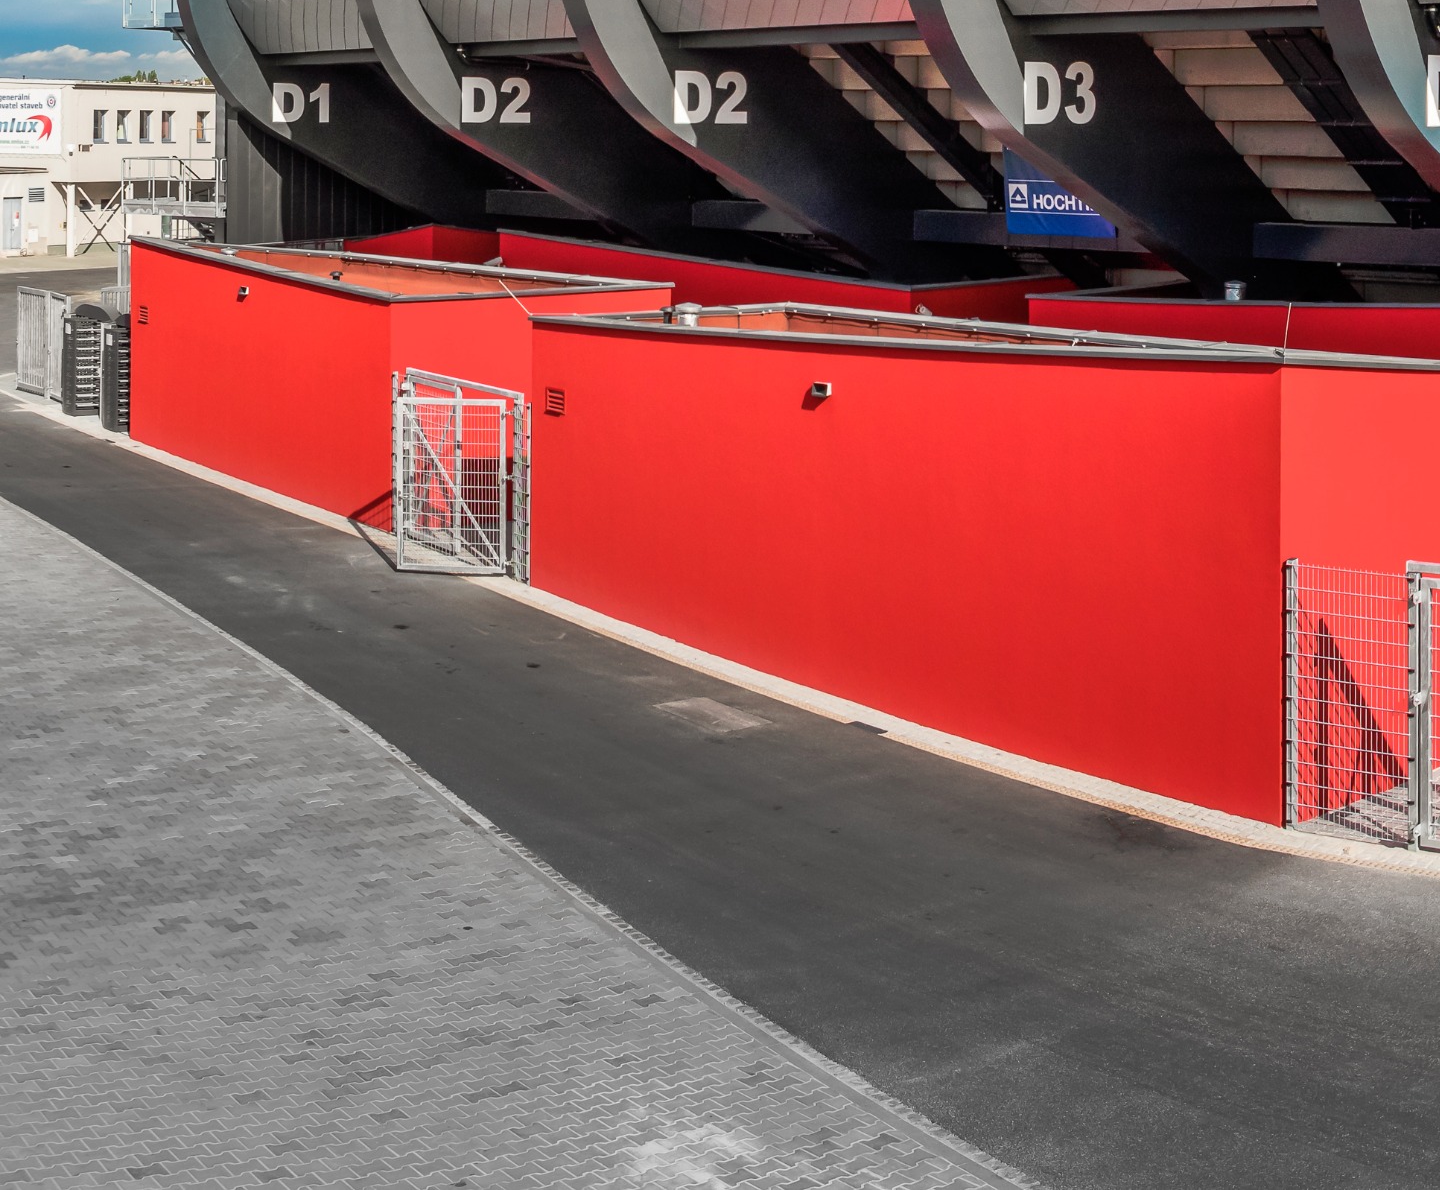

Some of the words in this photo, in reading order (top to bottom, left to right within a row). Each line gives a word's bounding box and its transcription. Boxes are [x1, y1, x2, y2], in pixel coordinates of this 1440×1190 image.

[272, 82, 330, 123] D1
[461, 77, 531, 124] D2
[673, 70, 748, 124] D2
[1024, 61, 1097, 125] D3
